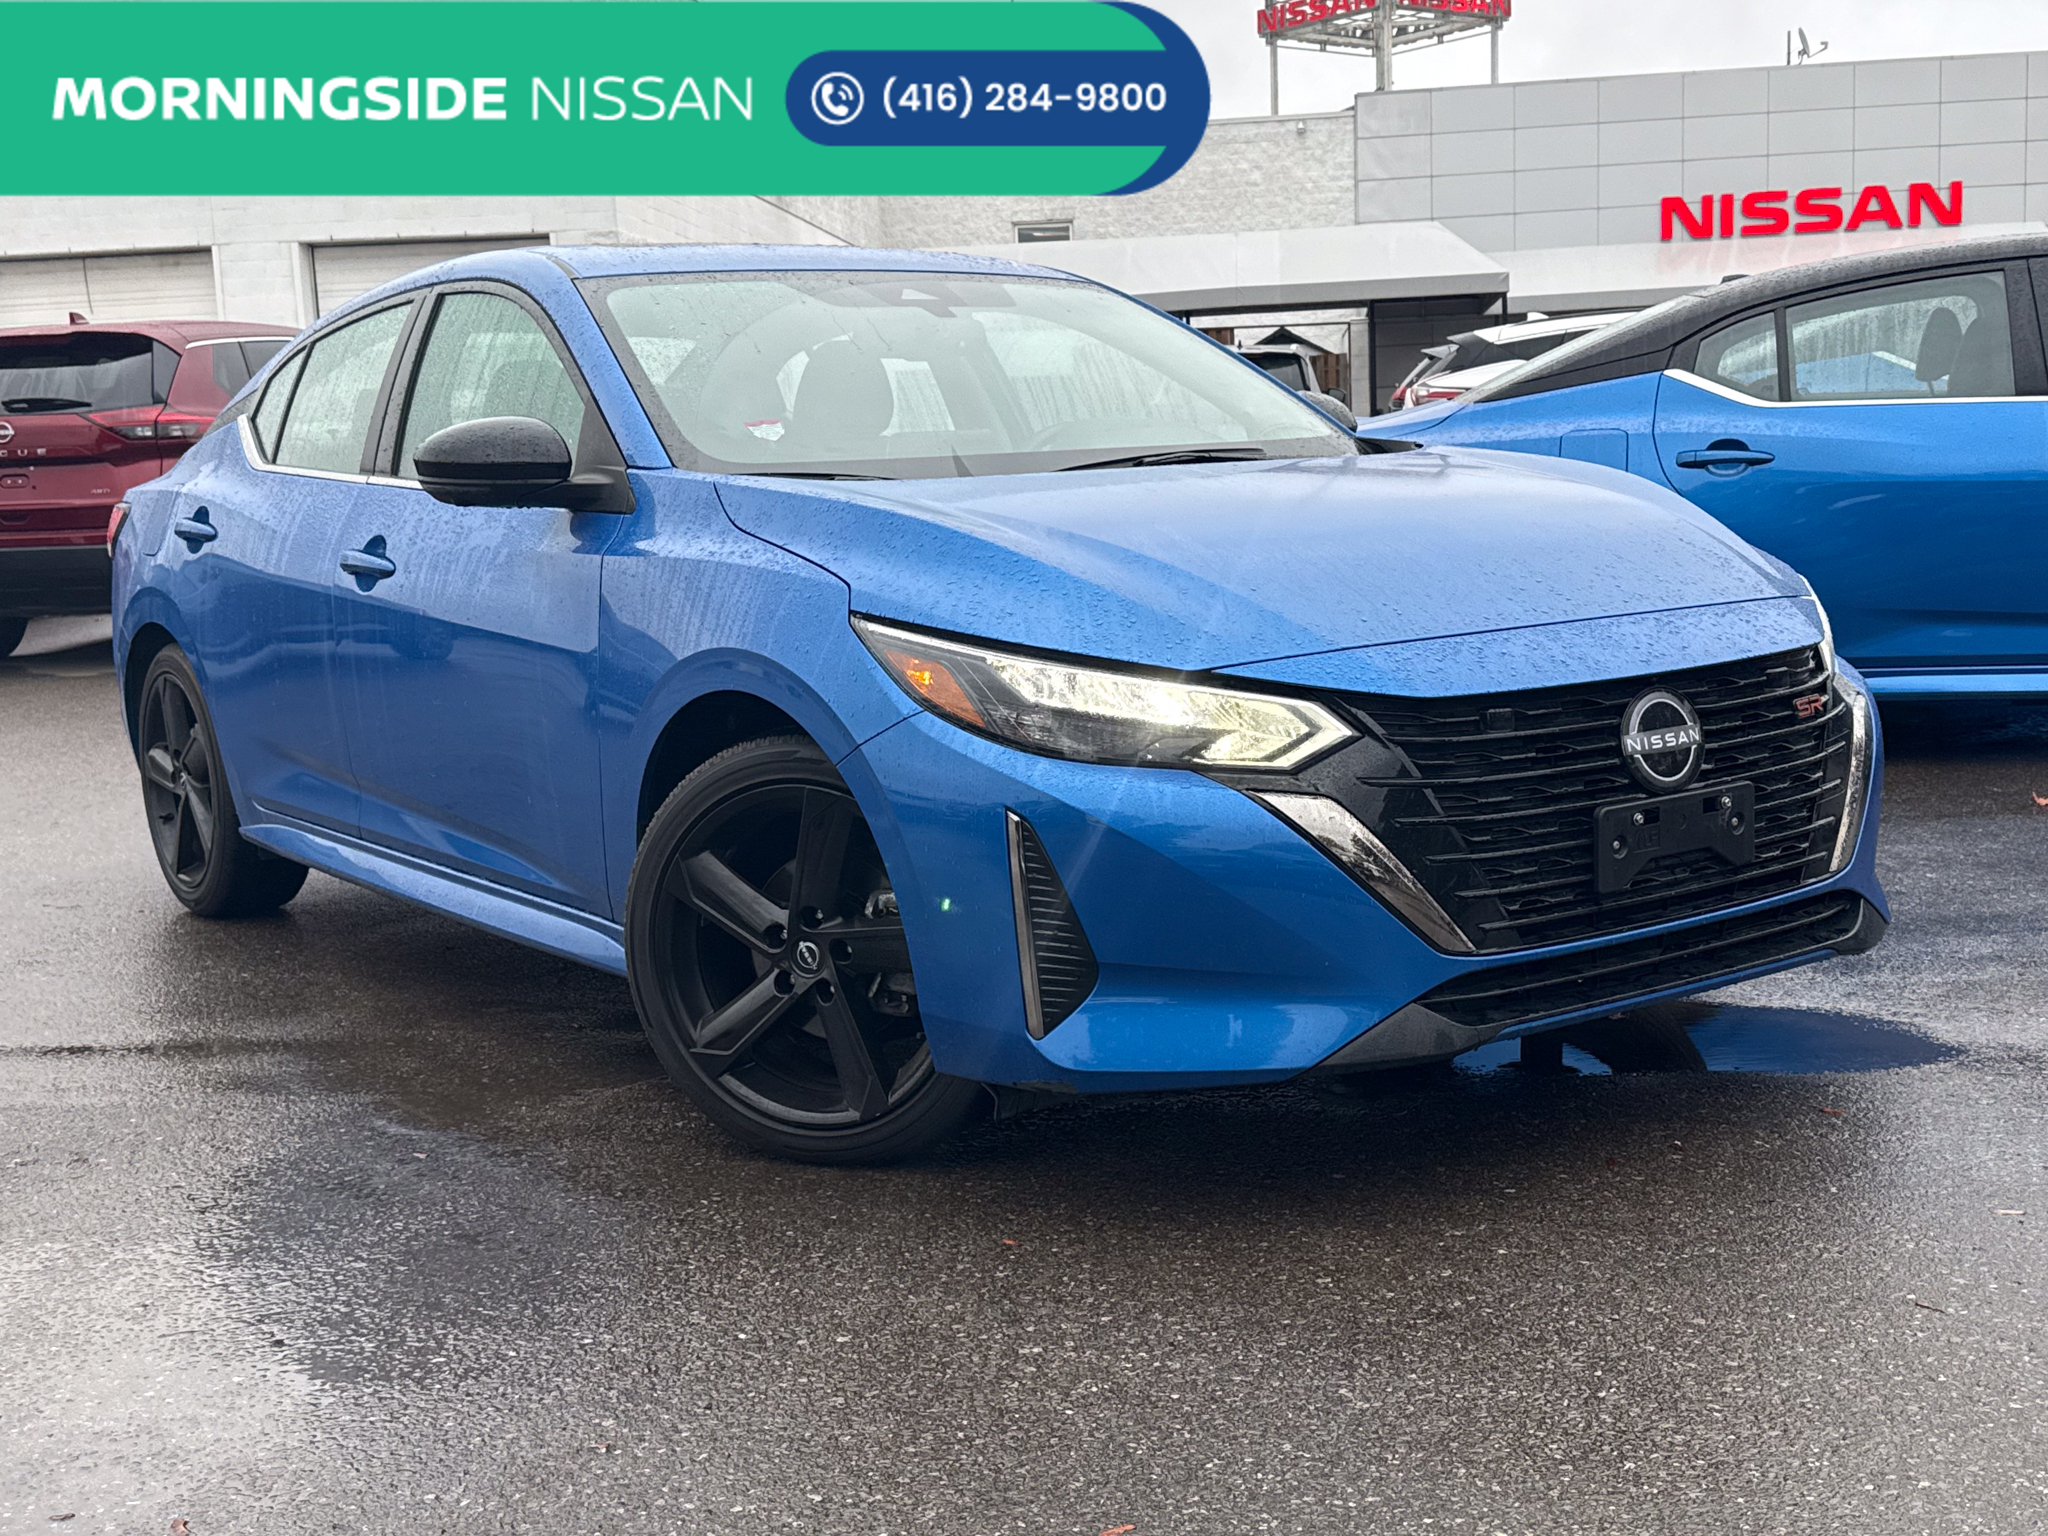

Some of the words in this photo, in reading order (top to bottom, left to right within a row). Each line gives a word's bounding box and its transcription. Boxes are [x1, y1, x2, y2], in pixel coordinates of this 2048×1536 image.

[1660, 180, 1963, 241] NISSAN
[1795, 694, 1825, 718] SR
[1626, 728, 1700, 752] NISSAN
